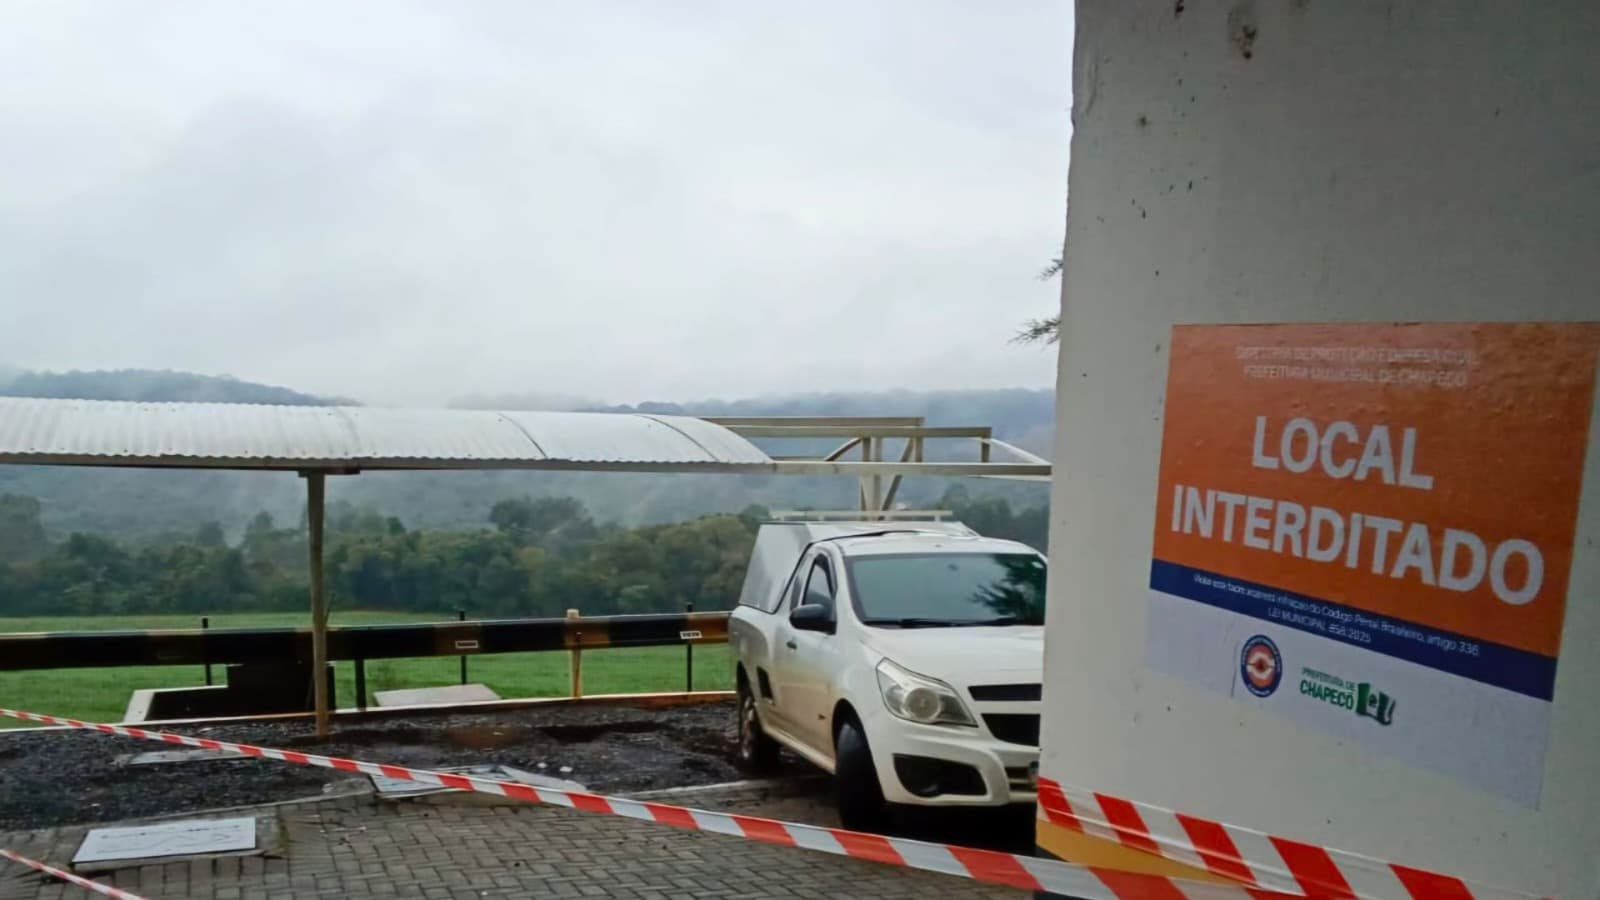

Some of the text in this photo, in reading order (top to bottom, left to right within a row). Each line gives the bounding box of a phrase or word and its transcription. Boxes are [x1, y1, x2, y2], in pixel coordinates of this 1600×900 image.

[1252, 416, 1434, 490] LOCAL
[1171, 485, 1544, 605] INTERDITADO
[1459, 641, 1480, 656] 336
